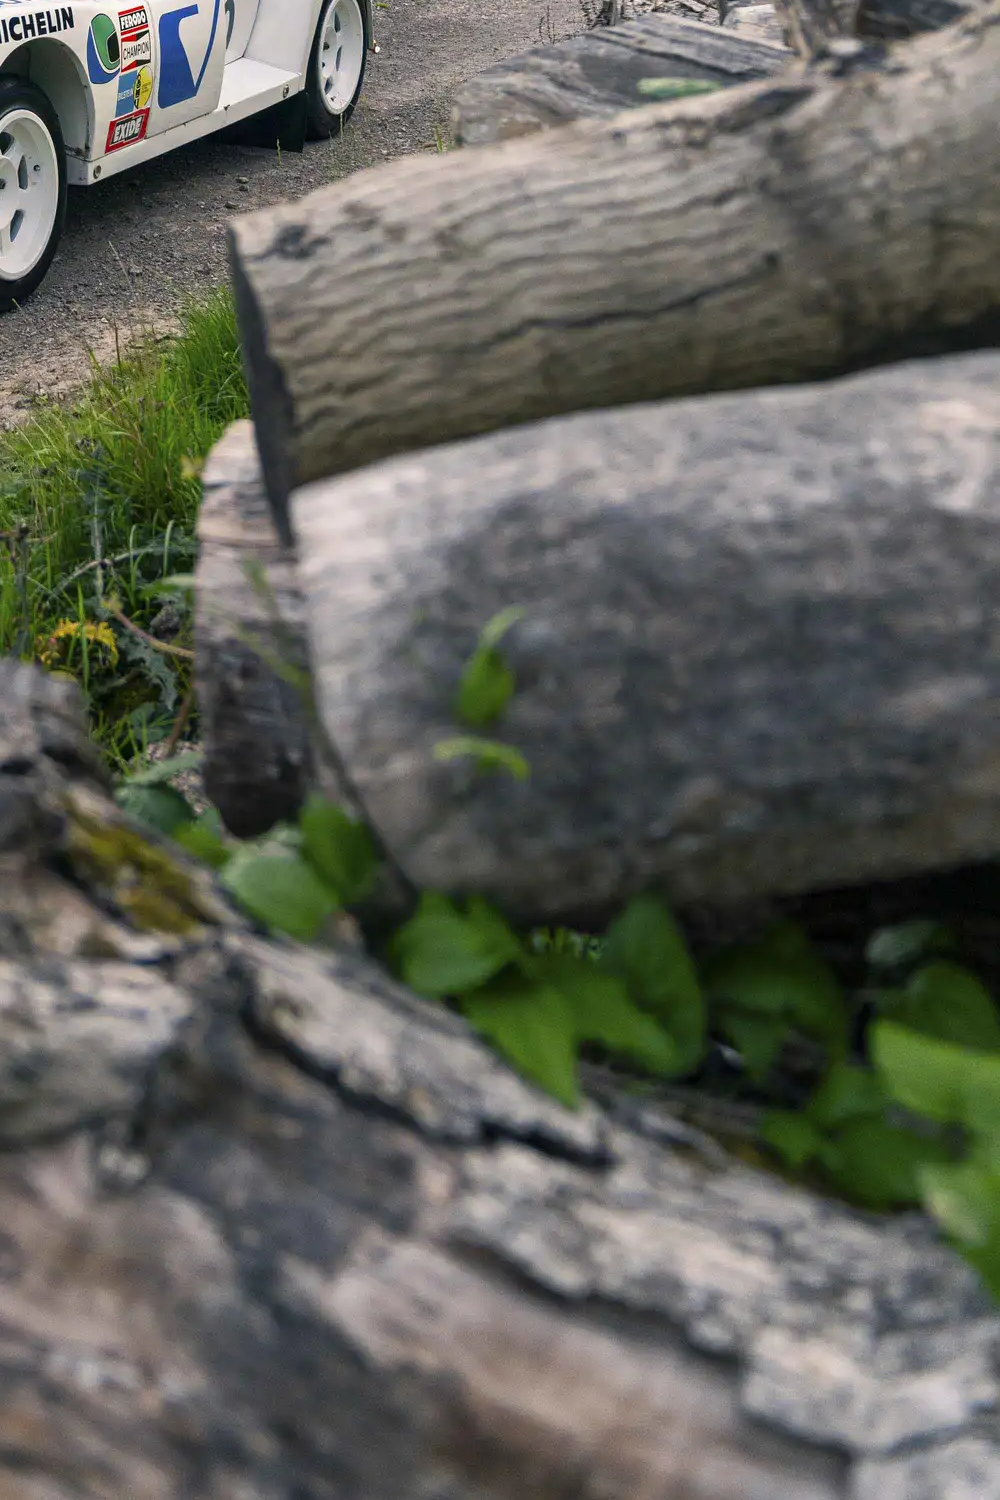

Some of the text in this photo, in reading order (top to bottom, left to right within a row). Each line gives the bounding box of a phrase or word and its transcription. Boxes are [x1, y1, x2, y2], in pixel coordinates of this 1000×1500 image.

[121, 11, 146, 30] FERODO
[122, 41, 149, 60] CHAMPION
[113, 116, 142, 143] EXIDE
